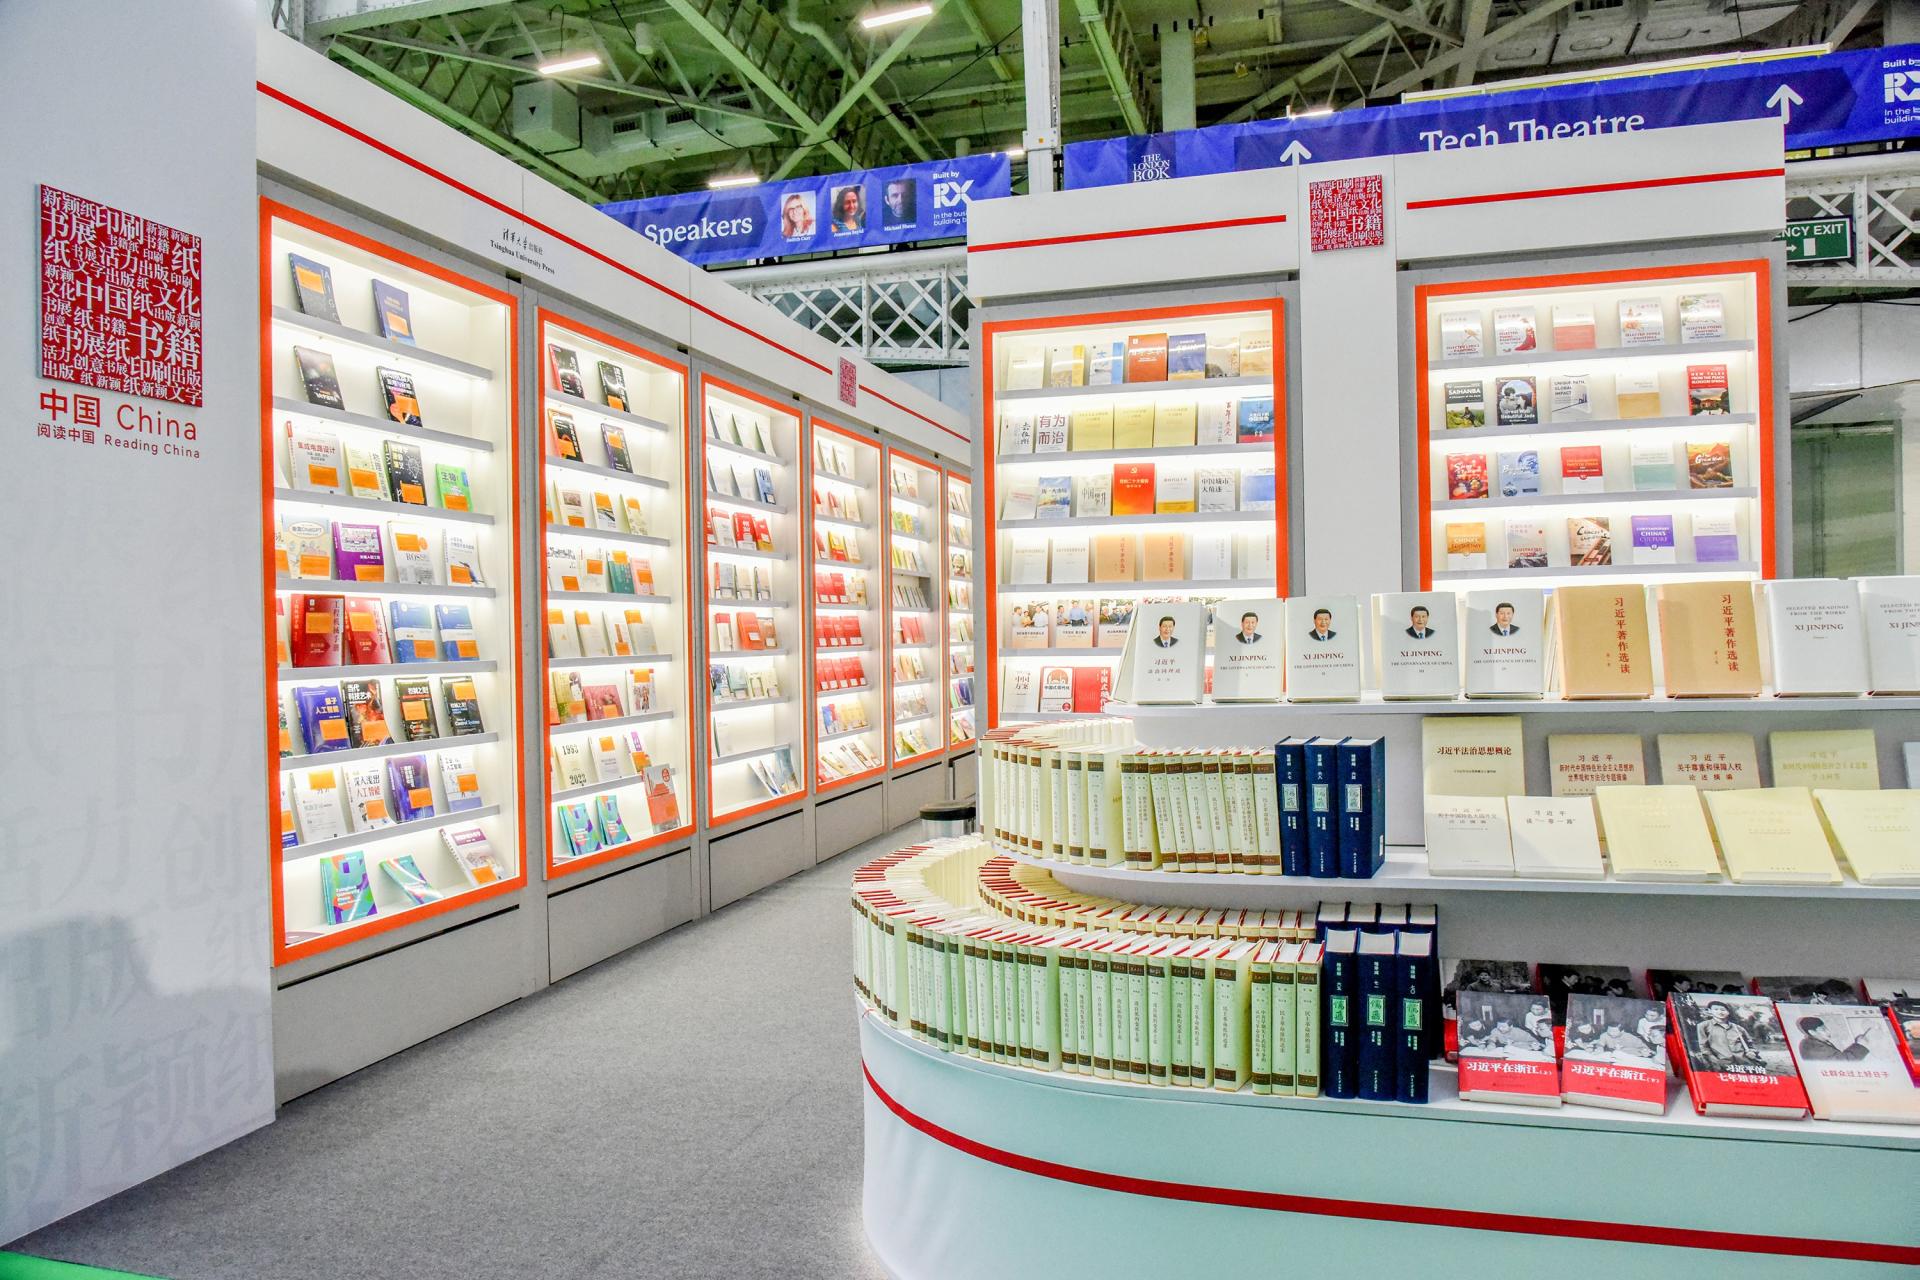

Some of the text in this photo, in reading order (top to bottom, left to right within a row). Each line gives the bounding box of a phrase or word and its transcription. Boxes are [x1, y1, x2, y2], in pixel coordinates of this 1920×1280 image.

[1883, 59, 1906, 68] Built
[1419, 113, 1645, 152] Tech Theatre
[1133, 160, 1170, 171] LONDON
[1141, 153, 1161, 163] THE
[1132, 167, 1170, 182] BOOK
[933, 180, 974, 209] RX
[1366, 180, 1381, 193] 纸
[41, 206, 97, 248] 书展
[95, 205, 144, 244] 印刷
[644, 215, 753, 247] Speakers
[1776, 223, 1844, 238] NCY EXIT
[43, 236, 71, 269] 纸
[99, 242, 138, 274] 活力
[171, 243, 200, 280] 纸
[490, 239, 555, 275] Tsinghua University Press
[45, 262, 74, 283] 新颖
[105, 268, 135, 288] 出版
[72, 256, 106, 279] 文字
[139, 259, 170, 284] 出版
[43, 297, 72, 317] 书展
[44, 276, 200, 320] 文化 中国 纸 文化
[43, 324, 131, 365] 纸 书展 纸
[74, 307, 94, 332] 纸
[95, 314, 128, 336] 书籍
[128, 315, 201, 369] 书籍
[43, 344, 71, 363] 活力
[74, 353, 104, 374] 创意
[130, 355, 172, 386] 印刷
[43, 360, 201, 386] 出版 出版
[80, 371, 94, 386] 纸
[123, 373, 141, 396] 纸
[167, 383, 202, 405] 文字
[40, 388, 197, 441] 中国 China
[1039, 414, 1066, 428] 有为
[37, 422, 200, 459] 阅读中国 Reading China
[1038, 430, 1065, 445] 而治
[1615, 597, 1630, 674] 习近平著作选读
[1721, 594, 1740, 672] 习近平著作选读
[1806, 623, 1844, 632] JINPING
[1154, 658, 1176, 666] 习近平
[1303, 652, 1344, 660] XI JINPING
[1437, 746, 1512, 756] 习近平法治思想概论
[1578, 754, 1614, 762] 习近平
[1690, 753, 1727, 762] 习近平
[1677, 763, 1743, 772] 关于尊重和保障人权
[1717, 1073, 1779, 1085] 七年知青岁月
[1726, 1063, 1767, 1075] 习近平的
[1820, 1069, 1890, 1078] 让群众过上好日子
